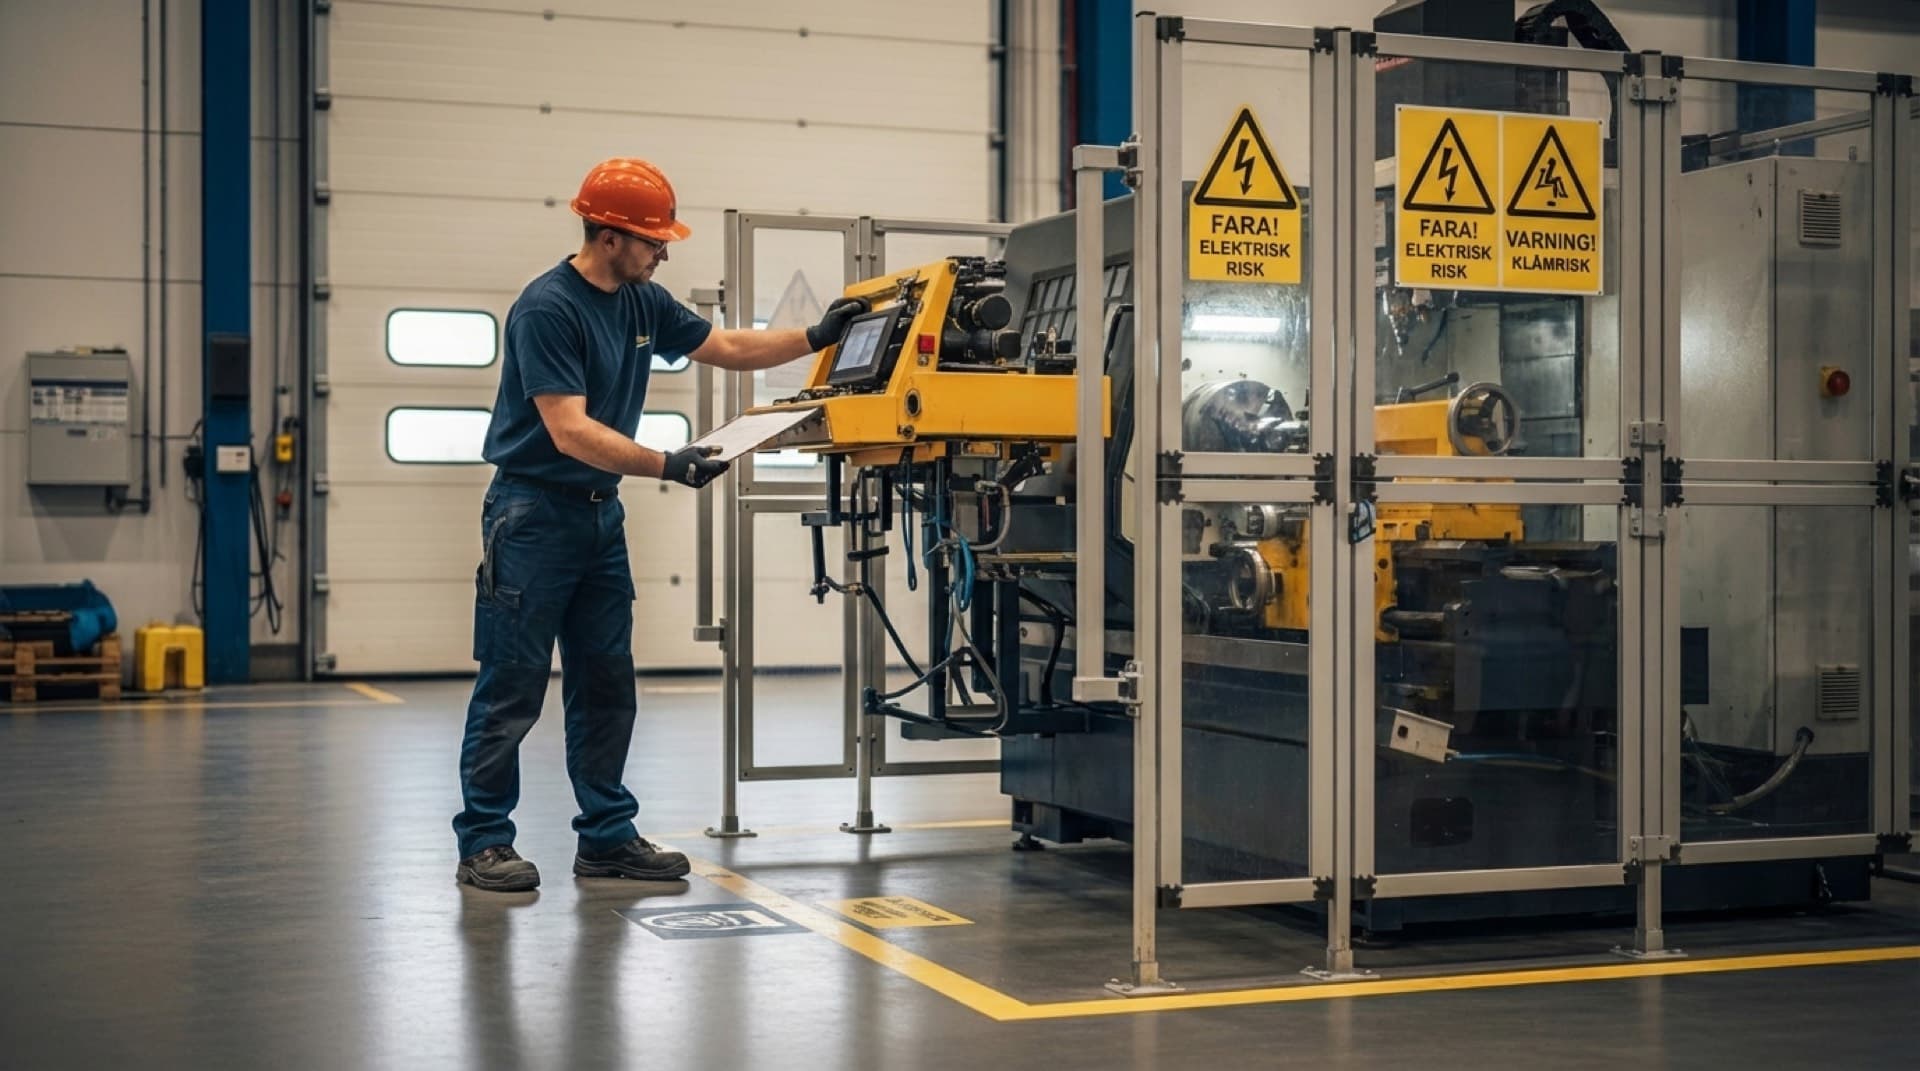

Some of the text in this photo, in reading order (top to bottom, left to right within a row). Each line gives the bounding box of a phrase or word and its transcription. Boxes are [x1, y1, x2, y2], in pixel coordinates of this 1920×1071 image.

[1212, 214, 1278, 236] FARA!
[1420, 218, 1478, 239] FARA!
[1200, 239, 1290, 258] ELEKTRISK
[1505, 230, 1596, 252] VARNING!
[1406, 242, 1492, 260] ELEKTRISK
[1226, 261, 1264, 277] RISK
[1431, 263, 1467, 279] RISK
